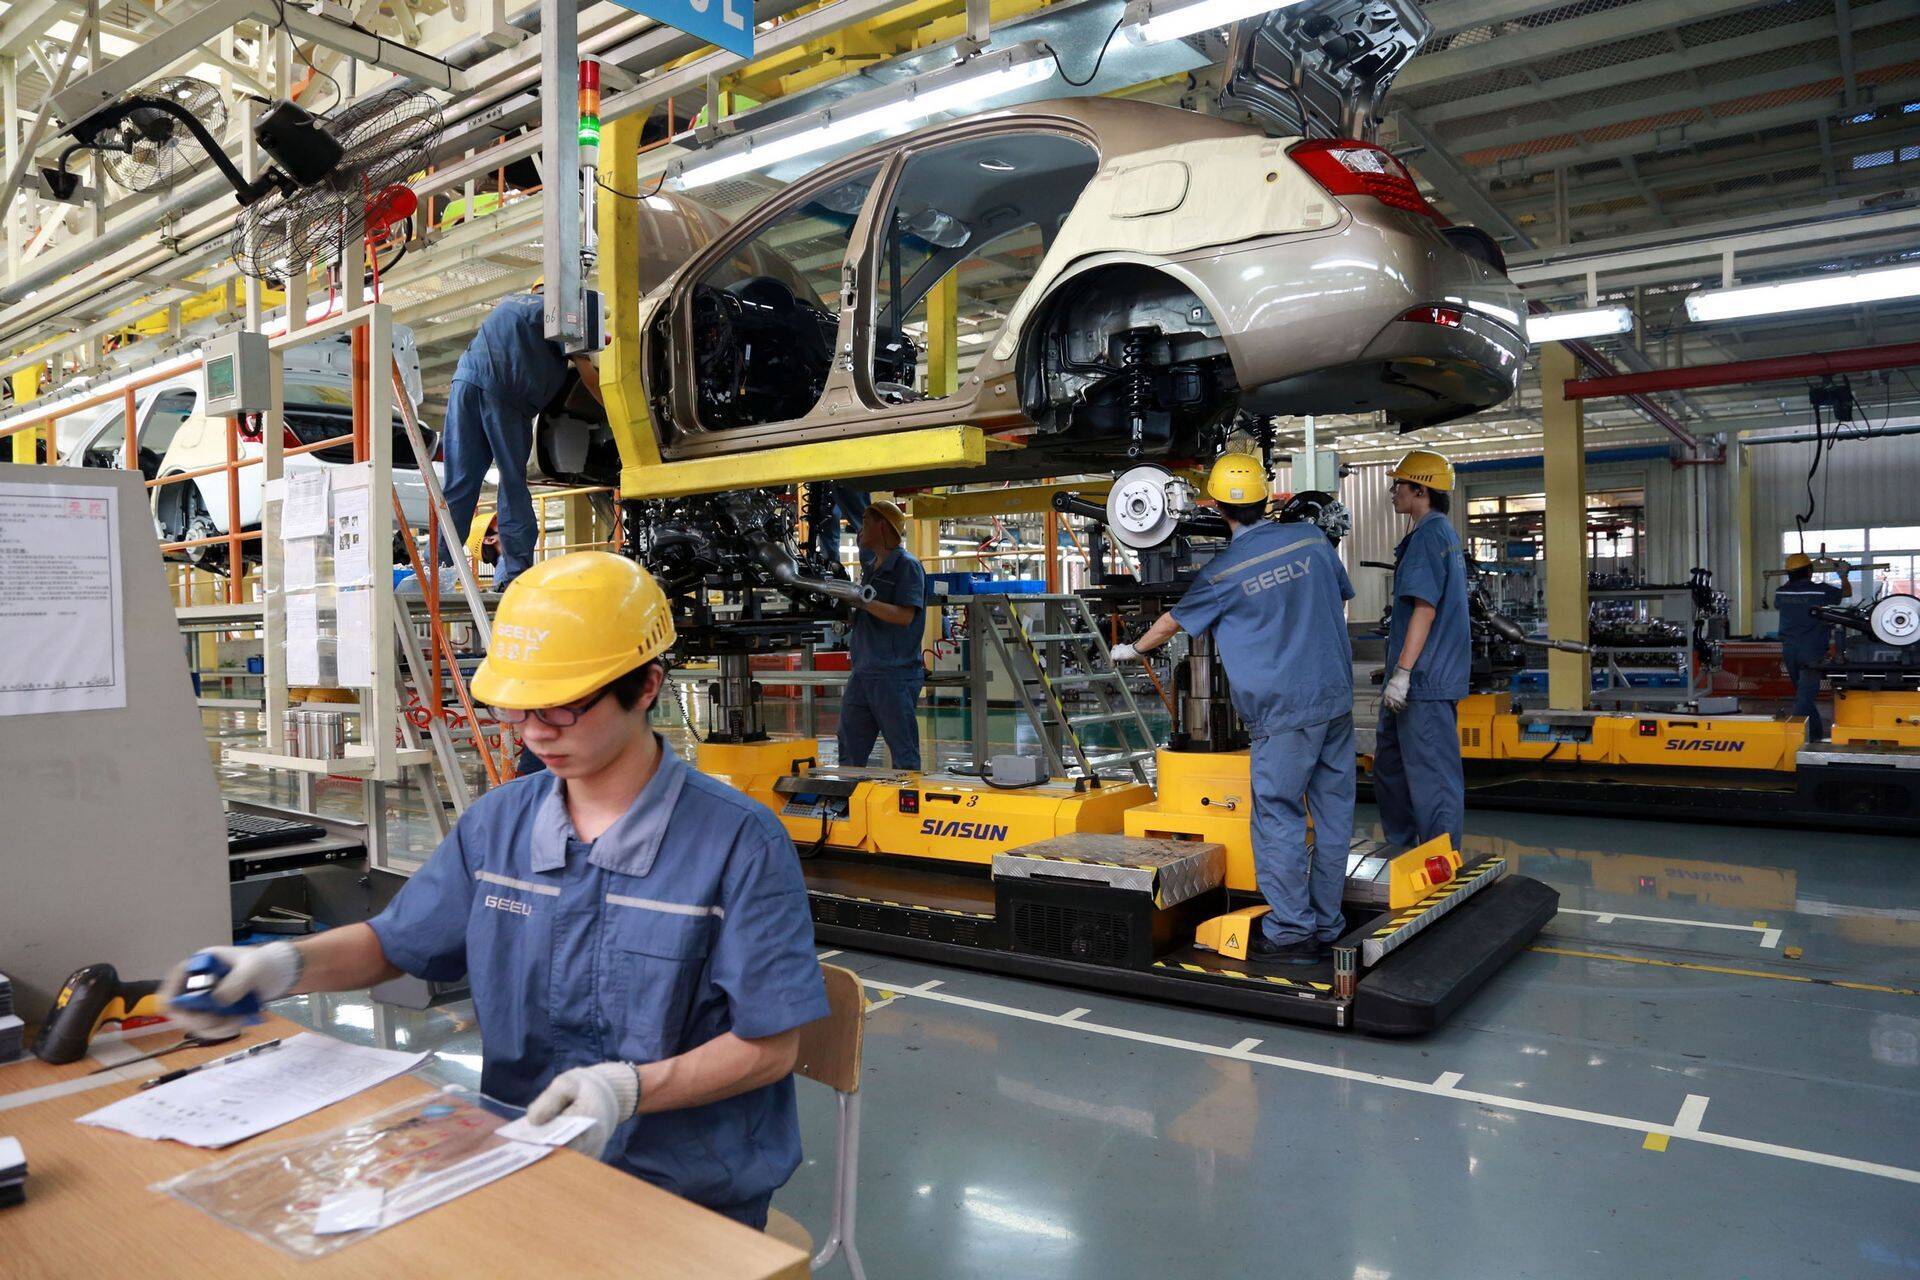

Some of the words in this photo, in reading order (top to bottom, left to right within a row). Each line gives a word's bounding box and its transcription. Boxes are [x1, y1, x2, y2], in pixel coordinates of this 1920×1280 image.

[1241, 555, 1311, 597] GEELY
[1664, 739, 1745, 752] SIASUN
[966, 795, 979, 808] 3
[920, 819, 1009, 841] SIASUN
